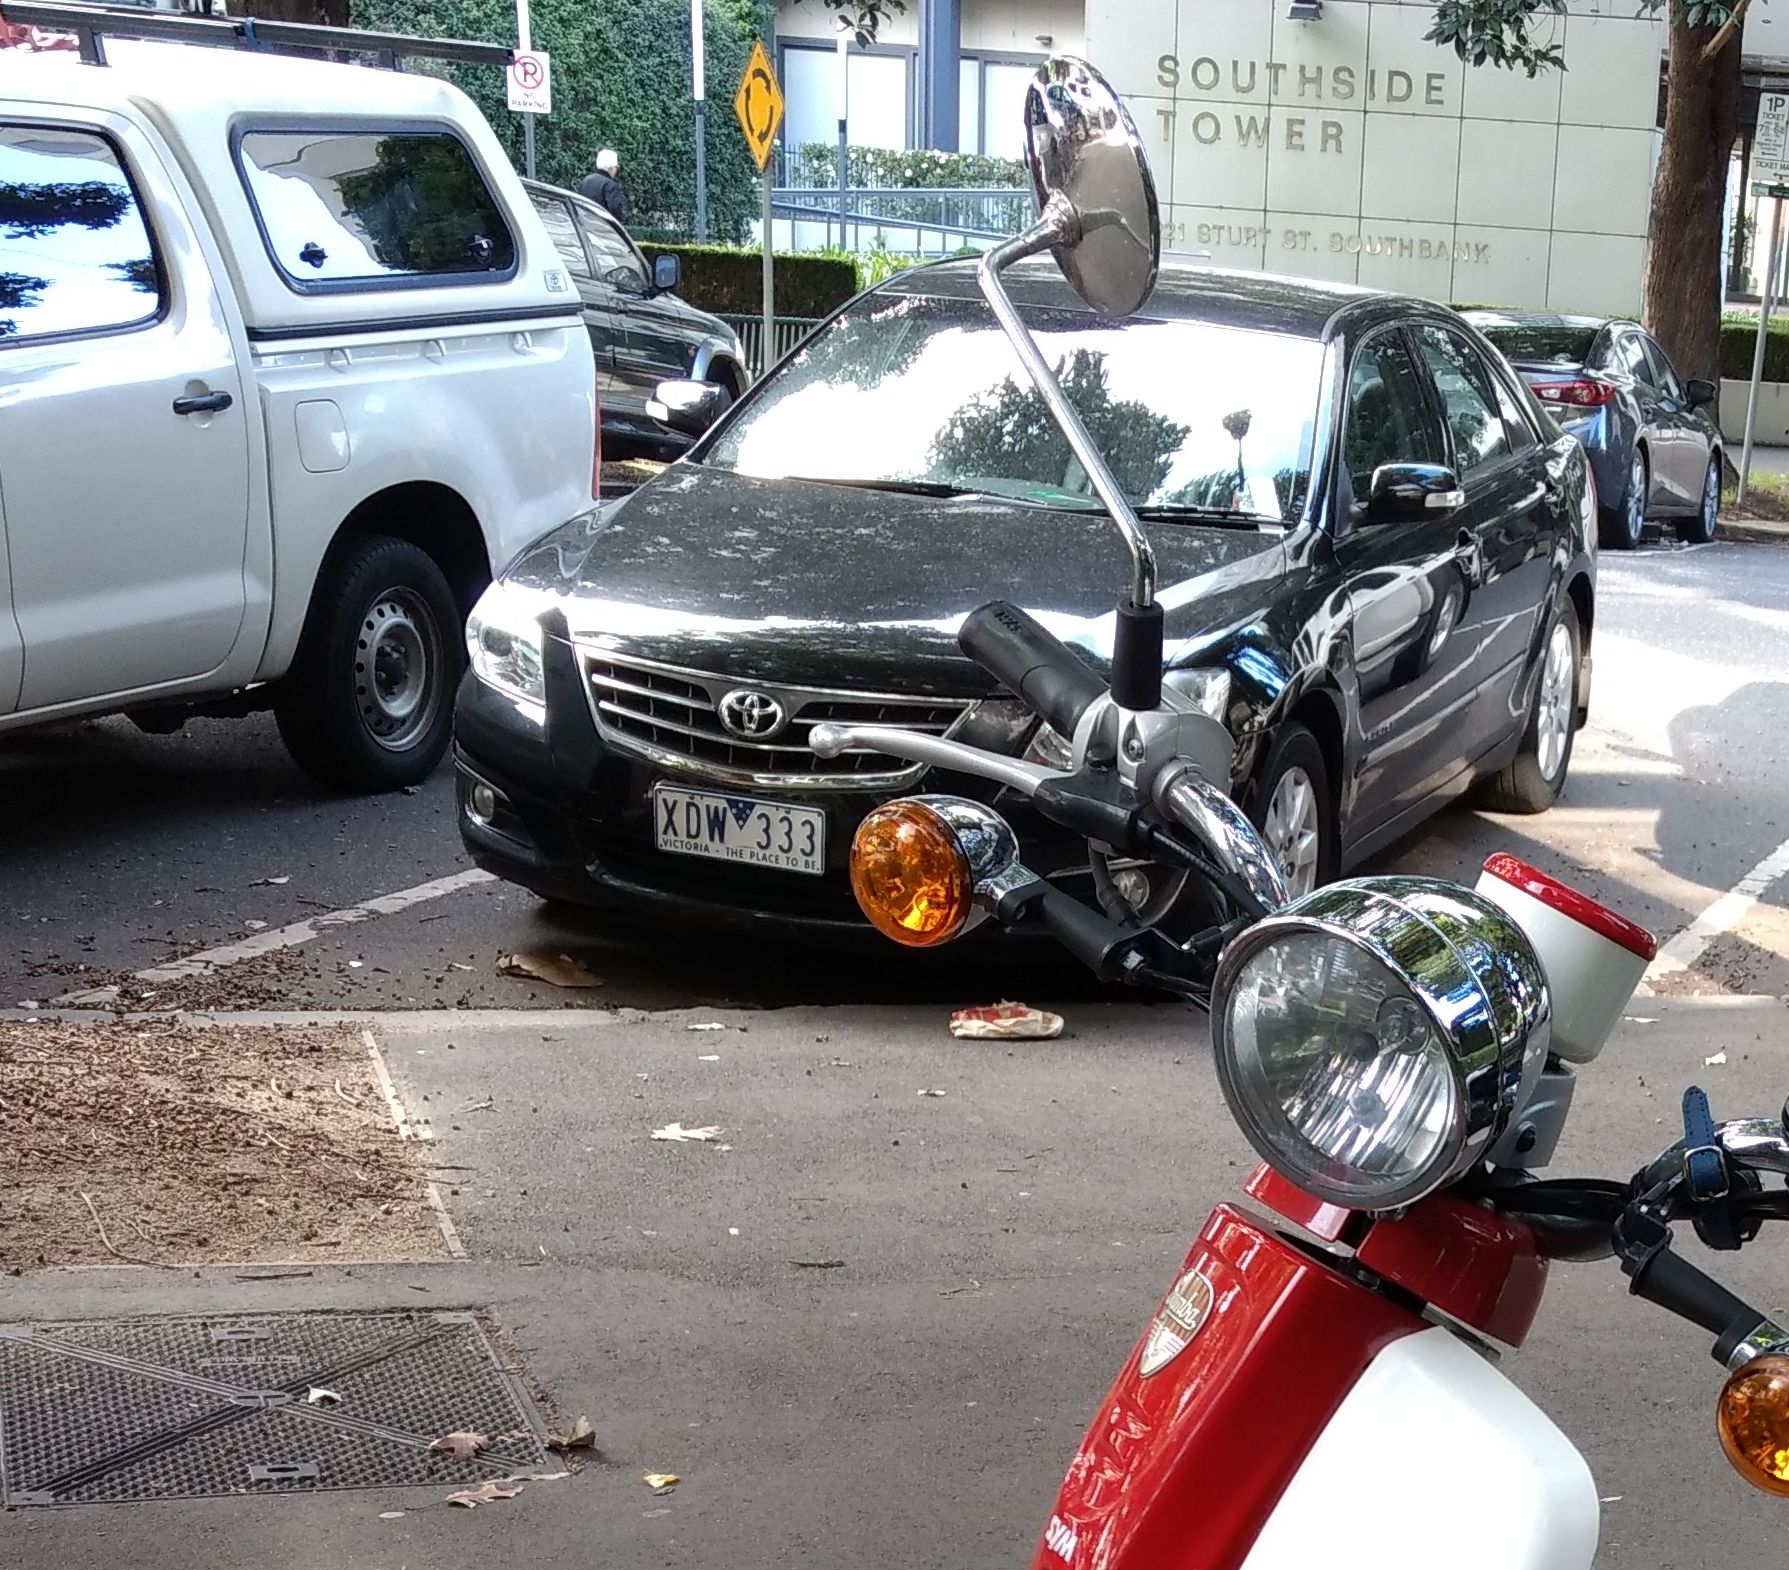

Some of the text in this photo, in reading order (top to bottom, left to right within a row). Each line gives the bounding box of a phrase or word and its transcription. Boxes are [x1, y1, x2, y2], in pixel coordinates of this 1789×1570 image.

[1156, 54, 1446, 106] SOUTHSIDE
[1766, 96, 1786, 113] 1P
[1156, 109, 1344, 154] TOWER
[1160, 222, 1490, 264] 21 STURT ST. SOUTHBANK
[661, 797, 816, 858] XDW 333
[662, 838, 710, 854] VICTORIA
[725, 846, 744, 859] THE
[750, 850, 780, 865] PLACE
[786, 856, 799, 868] TO
